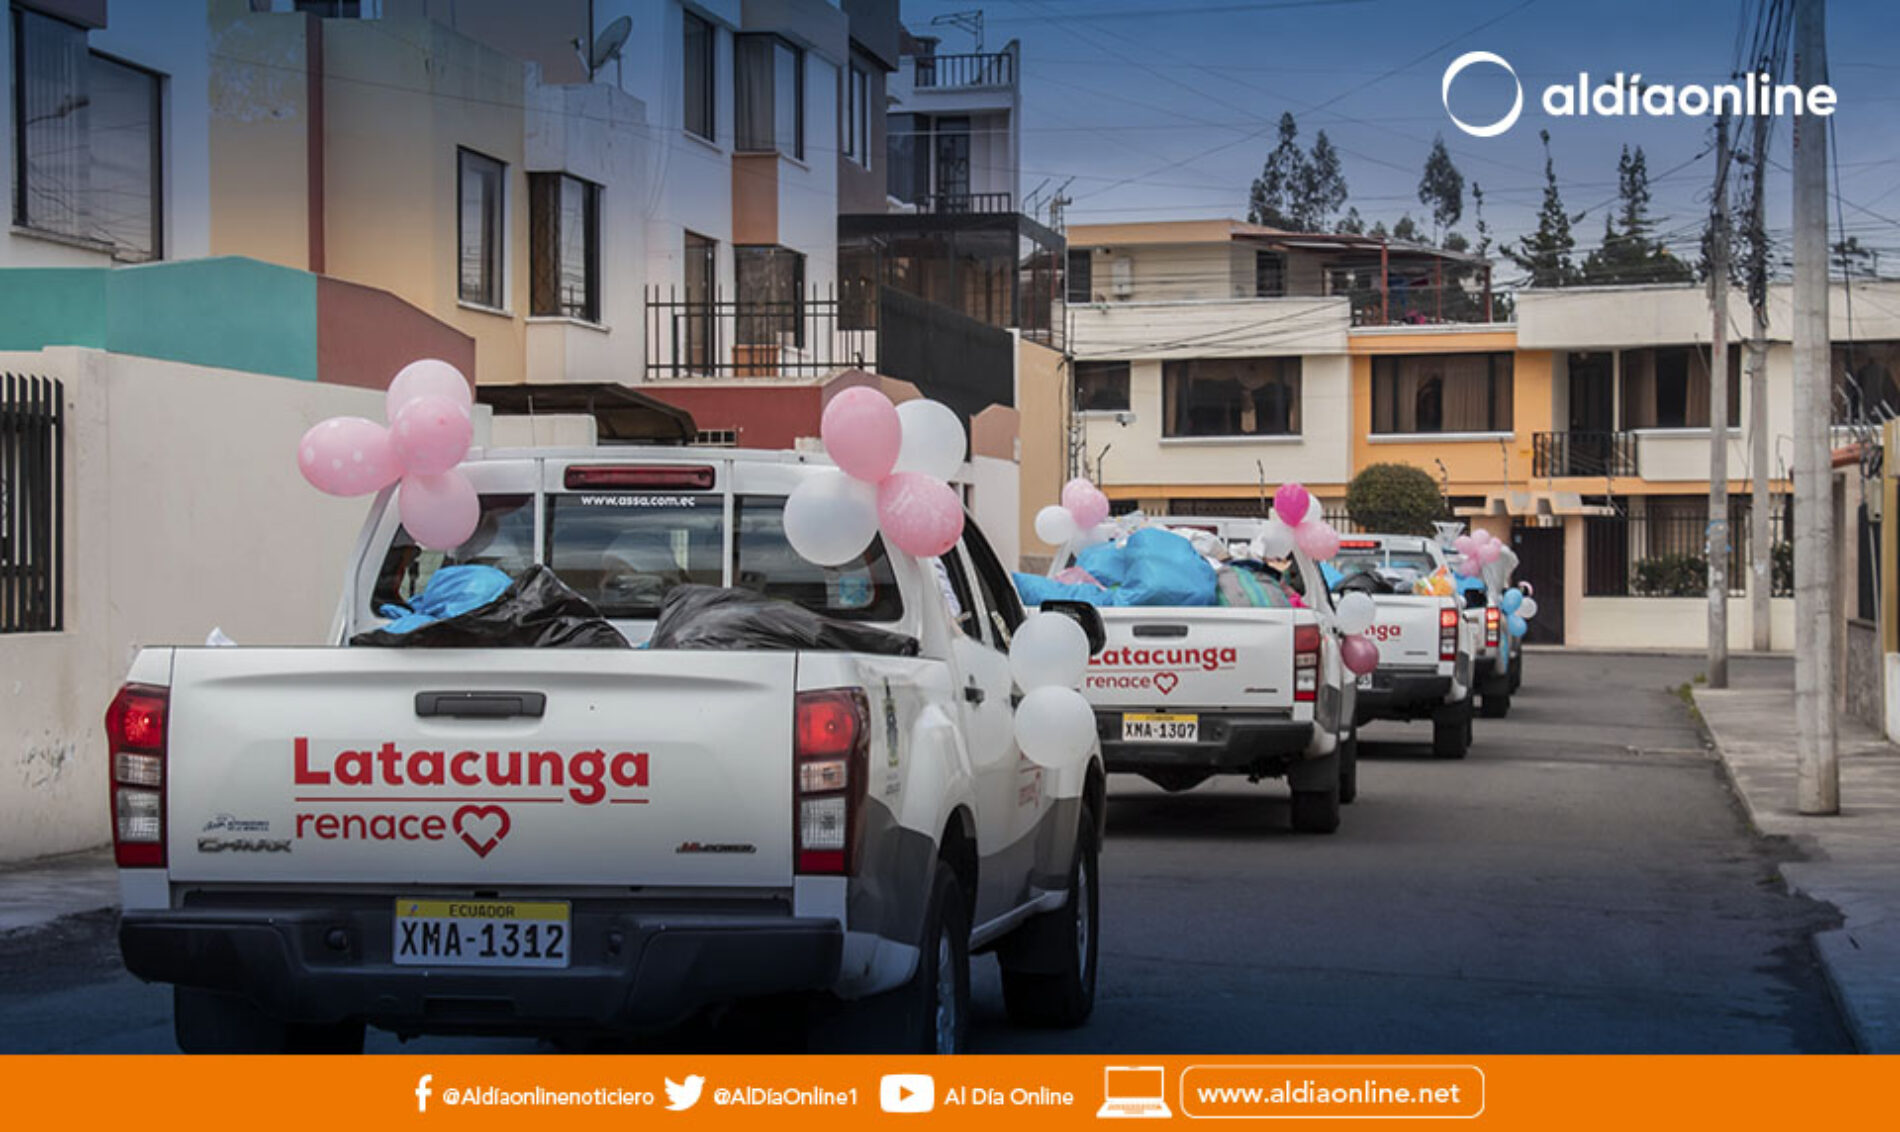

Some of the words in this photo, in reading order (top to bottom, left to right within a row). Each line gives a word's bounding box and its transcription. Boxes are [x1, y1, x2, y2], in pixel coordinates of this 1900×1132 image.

[581, 495, 696, 507] www.assa.com.ec
[1087, 646, 1237, 671] Latacunga
[1085, 675, 1151, 689] renace
[1125, 722, 1196, 739] XMA-1307
[294, 736, 650, 805] Latacunga
[296, 812, 447, 841] renace
[448, 903, 516, 918] ECUADOR
[399, 921, 564, 959] XMA-1312
